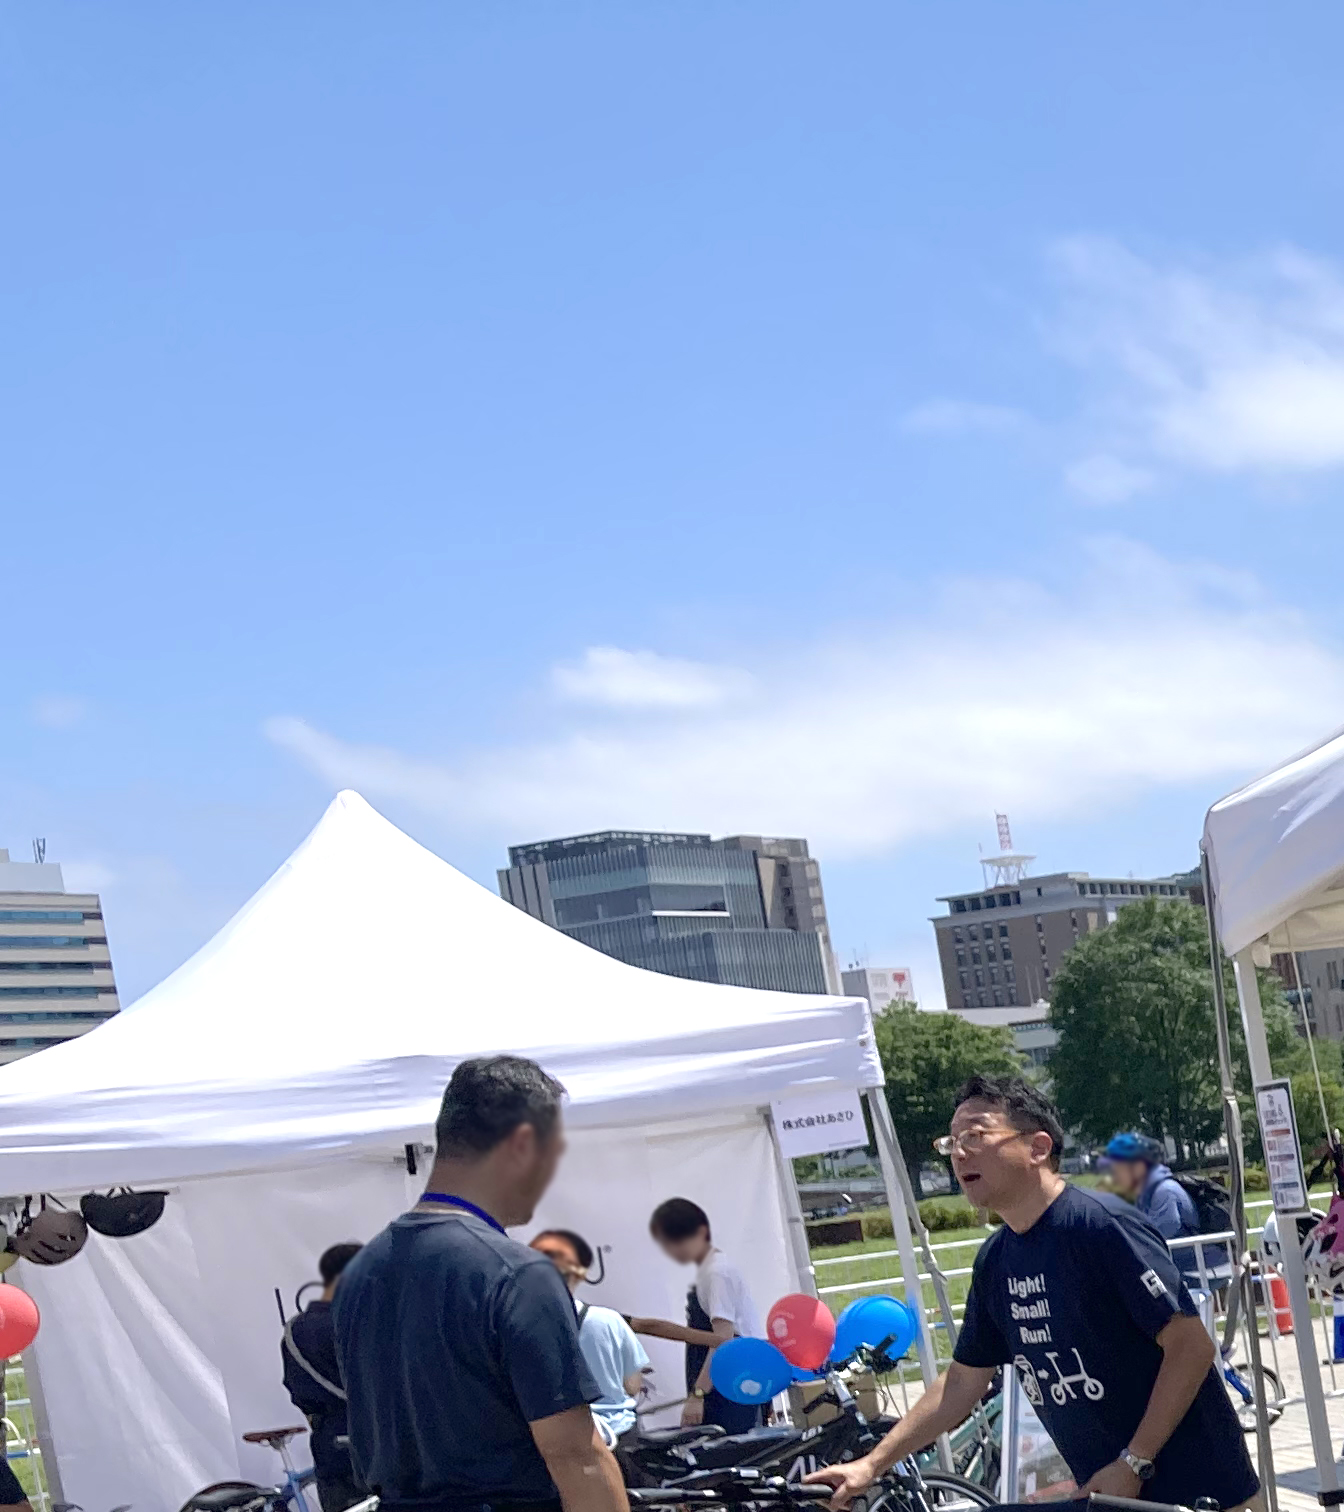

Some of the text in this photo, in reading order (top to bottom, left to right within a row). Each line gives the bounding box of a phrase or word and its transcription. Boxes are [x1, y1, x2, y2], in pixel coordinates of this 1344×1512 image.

[1007, 1273, 1046, 1299] Light!
[1010, 1298, 1051, 1321] Small!
[1019, 1323, 1052, 1344] Run!
